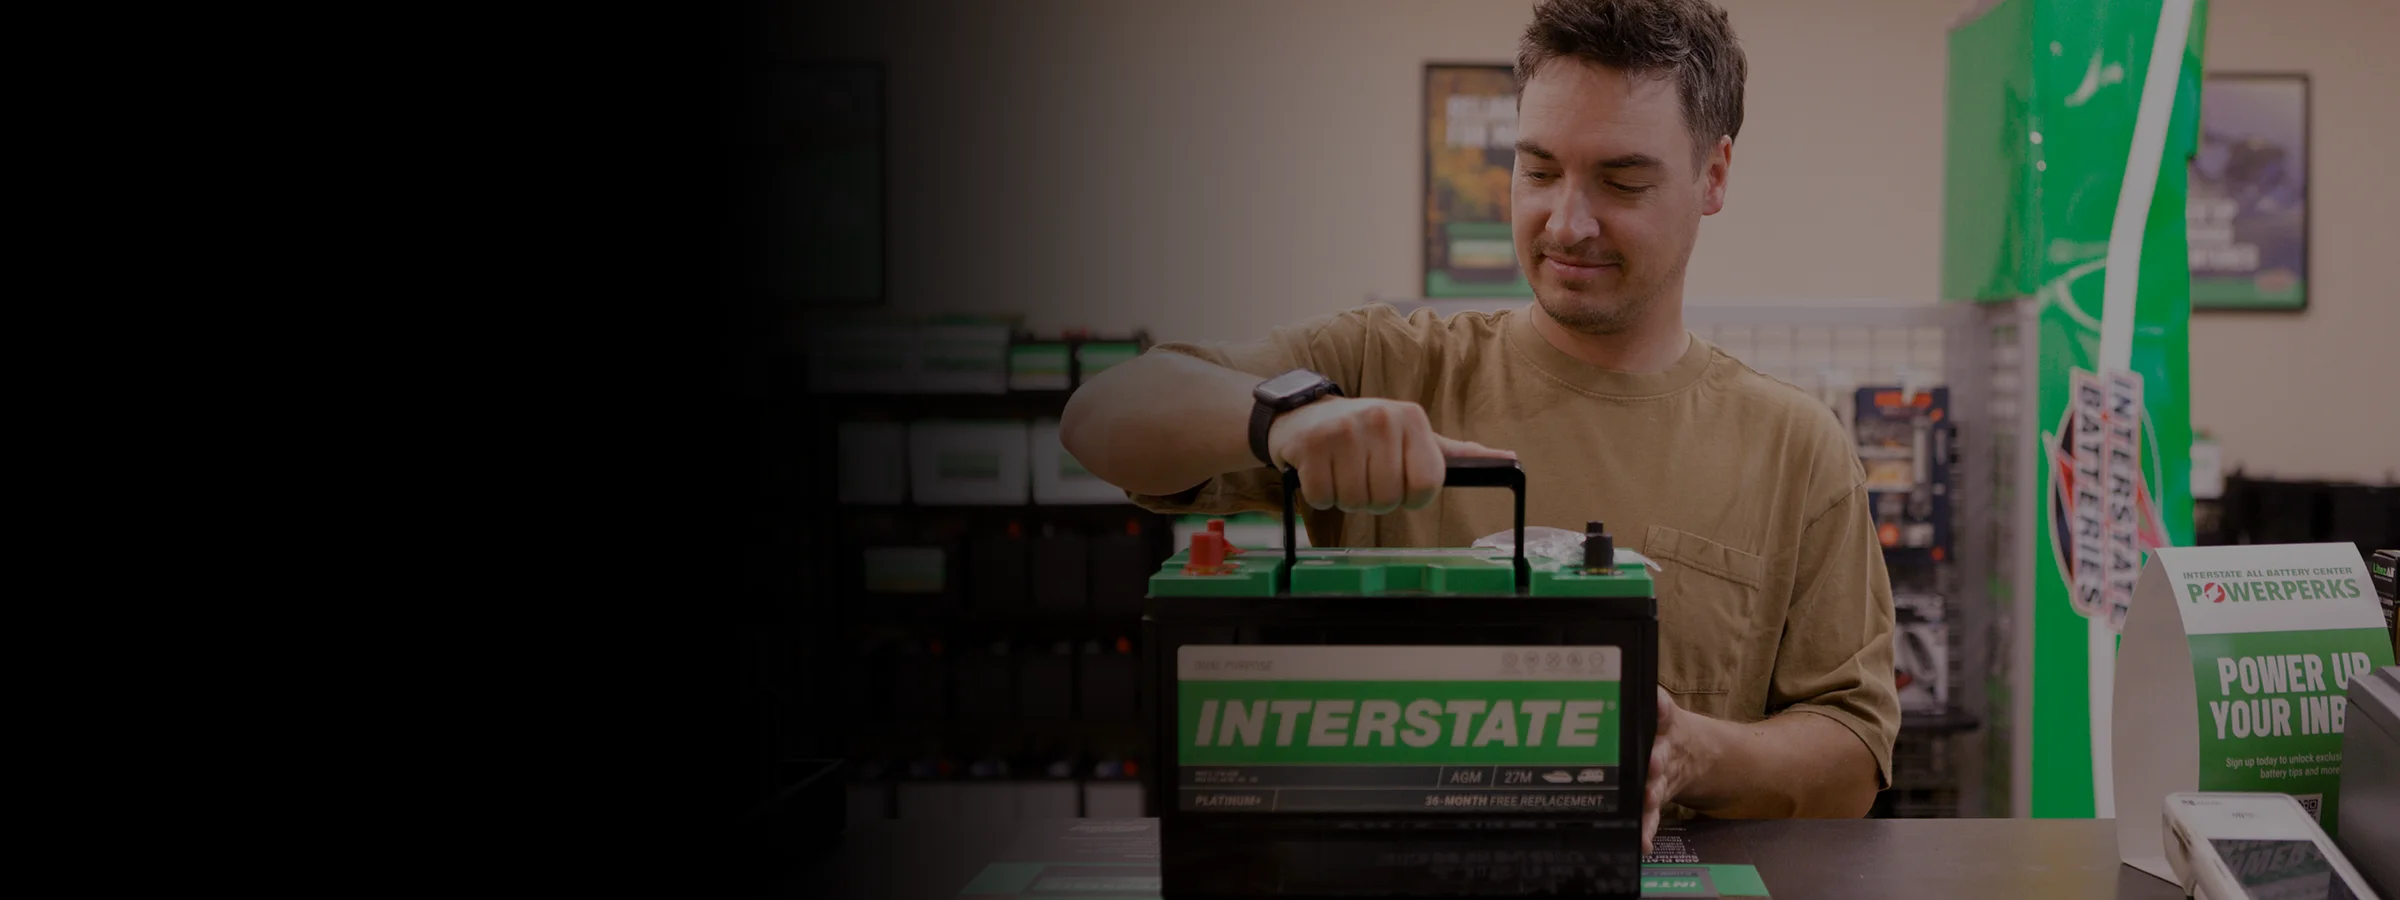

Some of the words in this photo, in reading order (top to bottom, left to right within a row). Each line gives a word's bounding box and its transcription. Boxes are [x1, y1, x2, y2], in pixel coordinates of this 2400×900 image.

[2080, 385, 2102, 606] BATTERIES
[2112, 379, 2134, 622] INTERSTATE
[2182, 570, 2243, 580] INTERSTATE
[2246, 569, 2265, 578] ALL
[2266, 568, 2311, 577] BATTERY
[2312, 567, 2353, 576] CENTER
[2186, 577, 2361, 604] POWERPERKS
[2216, 653, 2326, 696] POWER
[2331, 652, 2372, 691] UP
[1194, 699, 1606, 748] INTERSTATE
[2209, 697, 2293, 740] YOUR
[2225, 756, 2243, 770] Sign
[2244, 757, 2255, 768] up
[2256, 755, 2278, 767] today
[2279, 754, 2288, 765] to
[2289, 752, 2315, 764] unlock
[1450, 771, 1483, 784] AGM
[1503, 771, 1533, 784] 27M
[2260, 768, 2287, 780] battery
[2289, 767, 2304, 779] tips
[2304, 766, 2319, 776] and
[1194, 794, 1263, 807] PLATINUM+
[1424, 794, 1489, 807] 36-MONTH
[1489, 794, 1518, 807] FREE
[1519, 794, 1605, 808] REPLACEMENT
